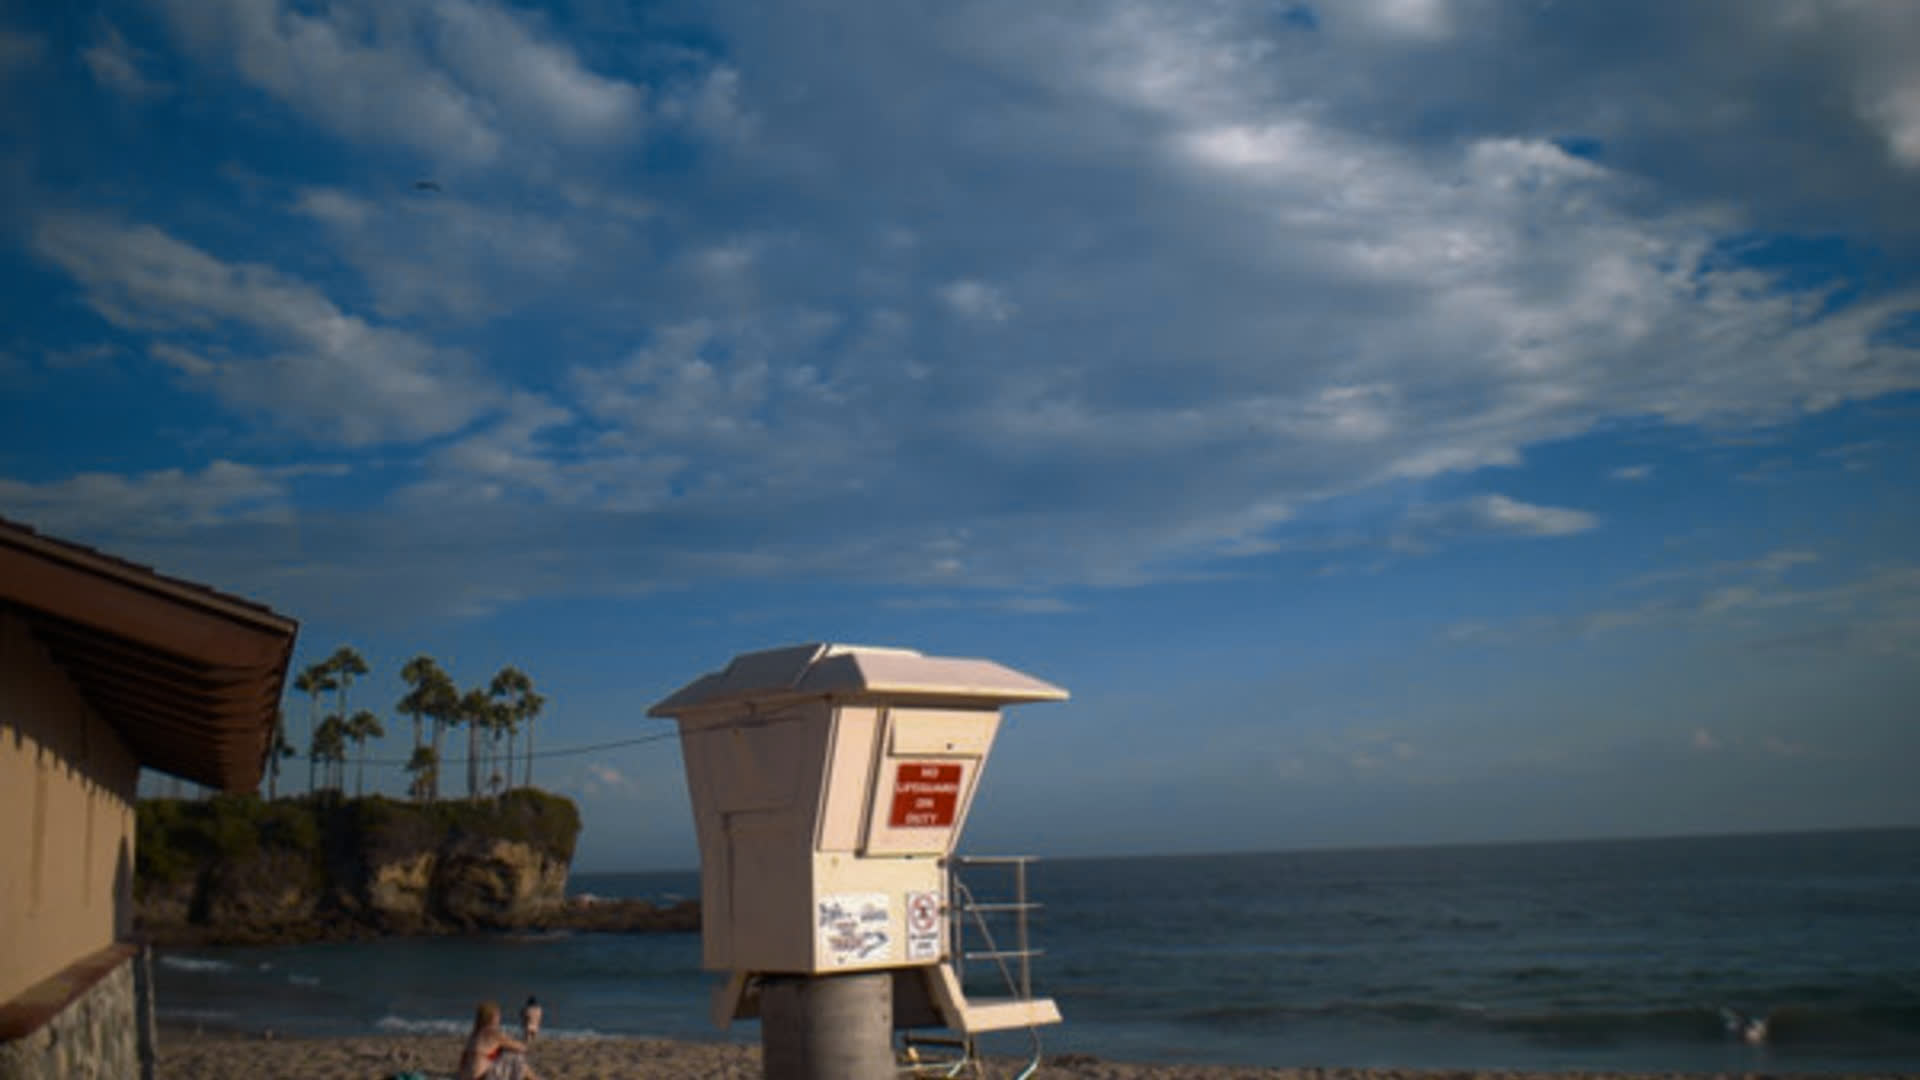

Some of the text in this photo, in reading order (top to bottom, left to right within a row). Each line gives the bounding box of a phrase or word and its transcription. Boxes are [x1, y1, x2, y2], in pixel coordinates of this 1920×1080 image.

[921, 767, 939, 778] NO
[896, 782, 959, 793] LIFEGUARD
[915, 799, 935, 809] ON
[905, 813, 938, 825] DUTY
